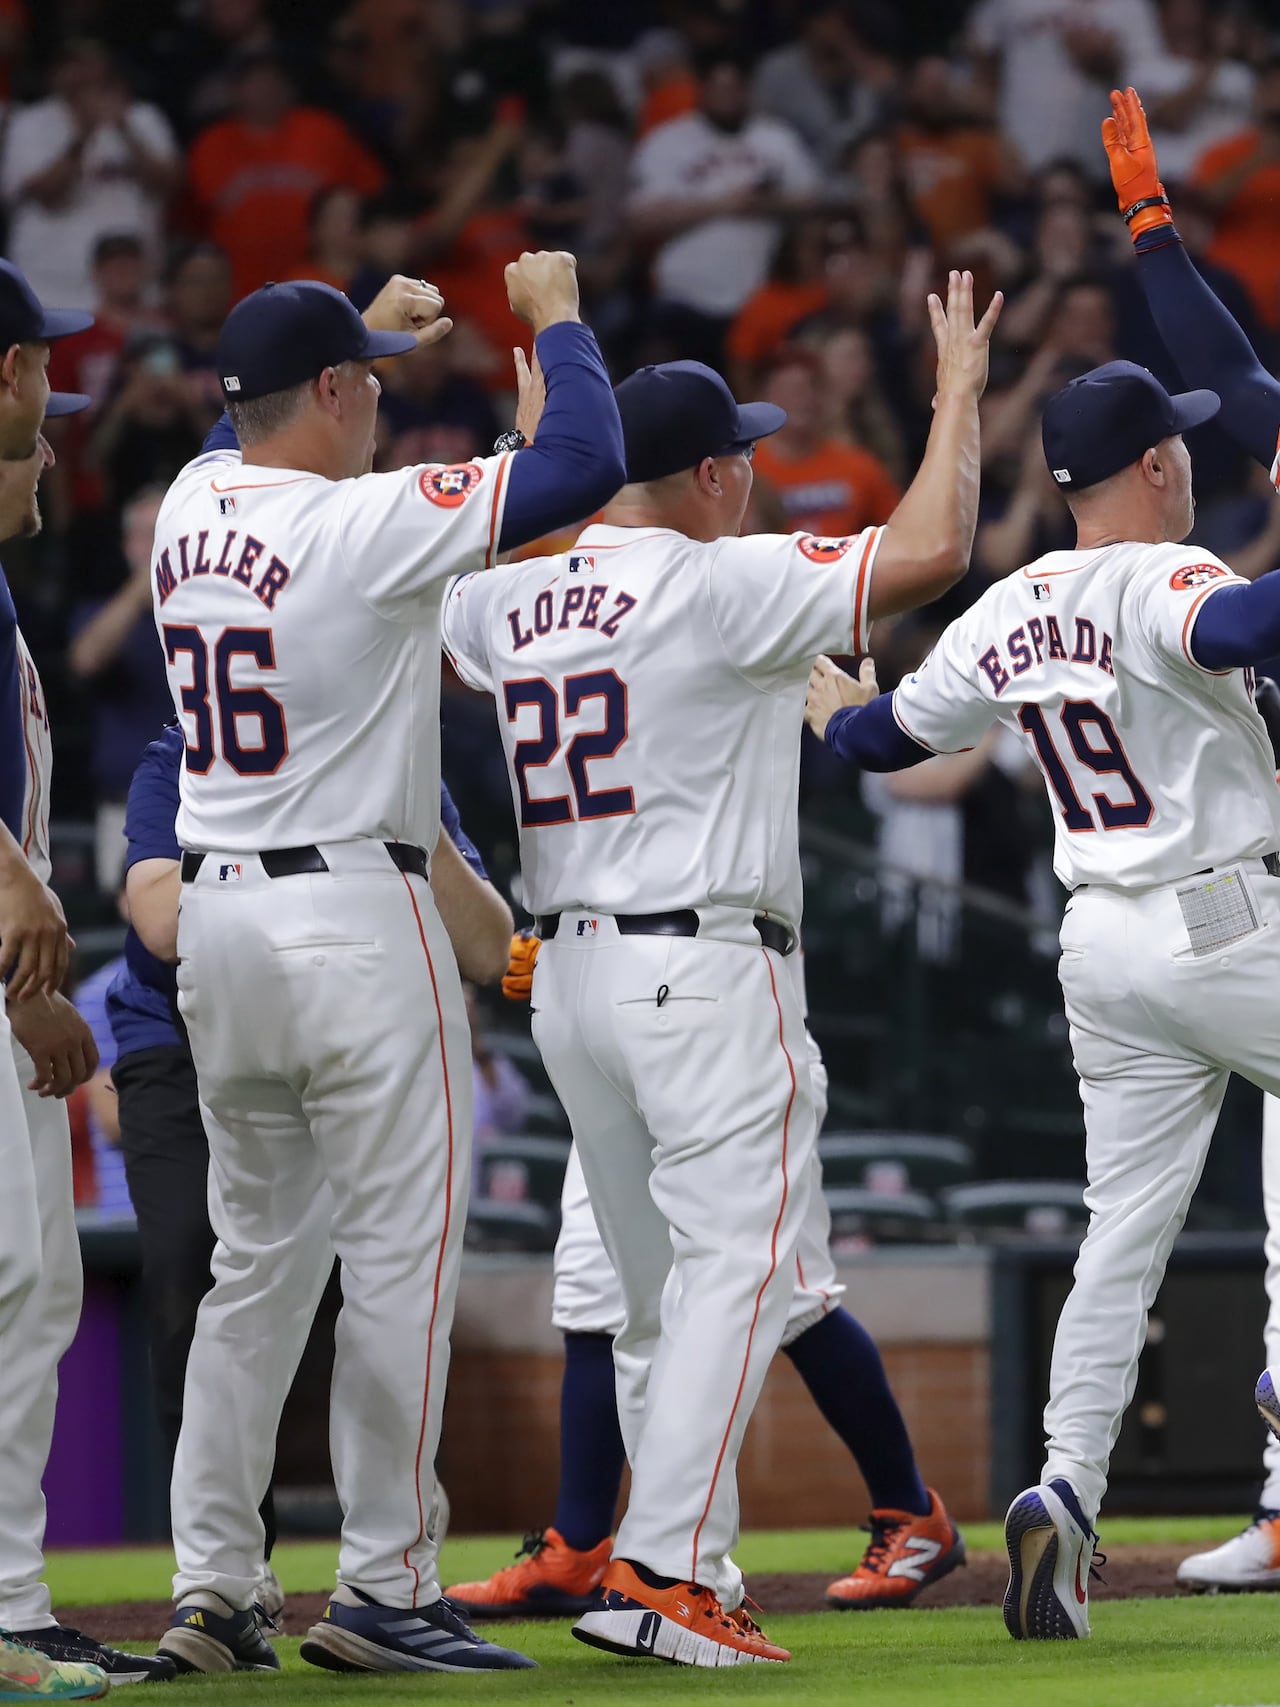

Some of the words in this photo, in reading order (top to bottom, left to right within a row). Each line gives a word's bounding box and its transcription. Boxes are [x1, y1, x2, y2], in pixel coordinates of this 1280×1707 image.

[155, 529, 291, 612] MILLER
[161, 623, 290, 777] 36
[977, 615, 1115, 698] ESPADA
[502, 667, 636, 828] 22
[1017, 698, 1156, 833] 19
